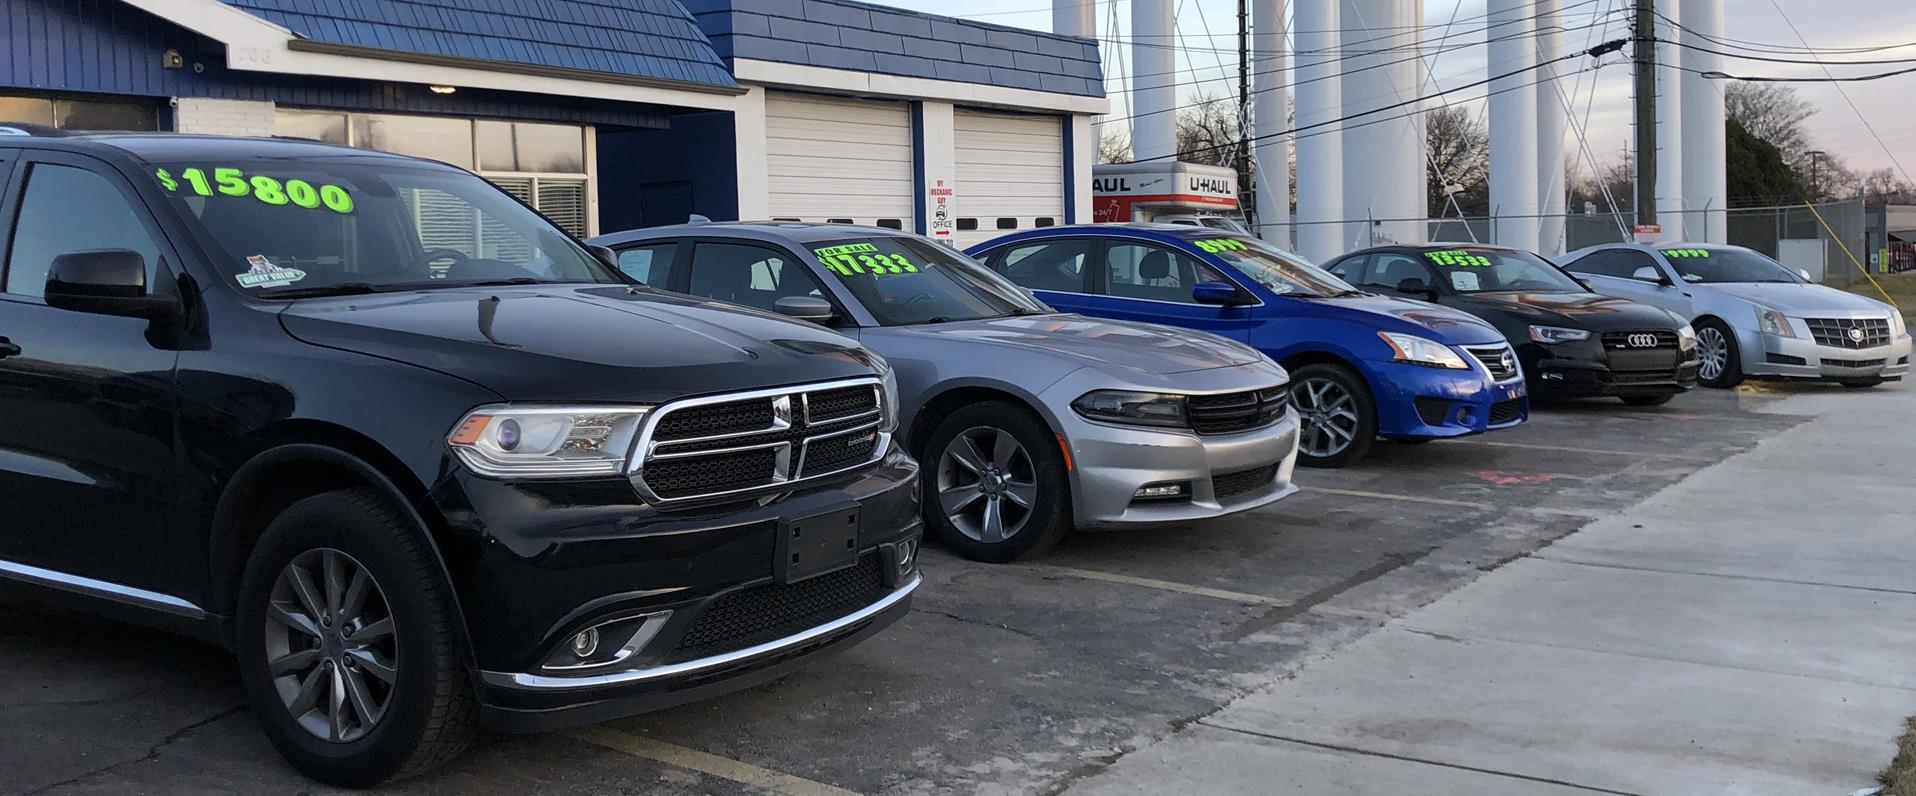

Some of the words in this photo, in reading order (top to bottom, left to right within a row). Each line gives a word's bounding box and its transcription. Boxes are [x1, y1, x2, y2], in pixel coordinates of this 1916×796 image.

[156, 168, 354, 213] $15800
[1093, 178, 1131, 192] AUL
[1190, 177, 1231, 194] U-HAUL
[932, 221, 953, 229] OFFICE
[818, 247, 844, 257] FOR
[845, 243, 875, 253] SALE
[817, 253, 918, 276] $17333
[243, 273, 269, 285] GREAT
[269, 270, 297, 281] VALUE
[848, 434, 872, 447] DODGE
